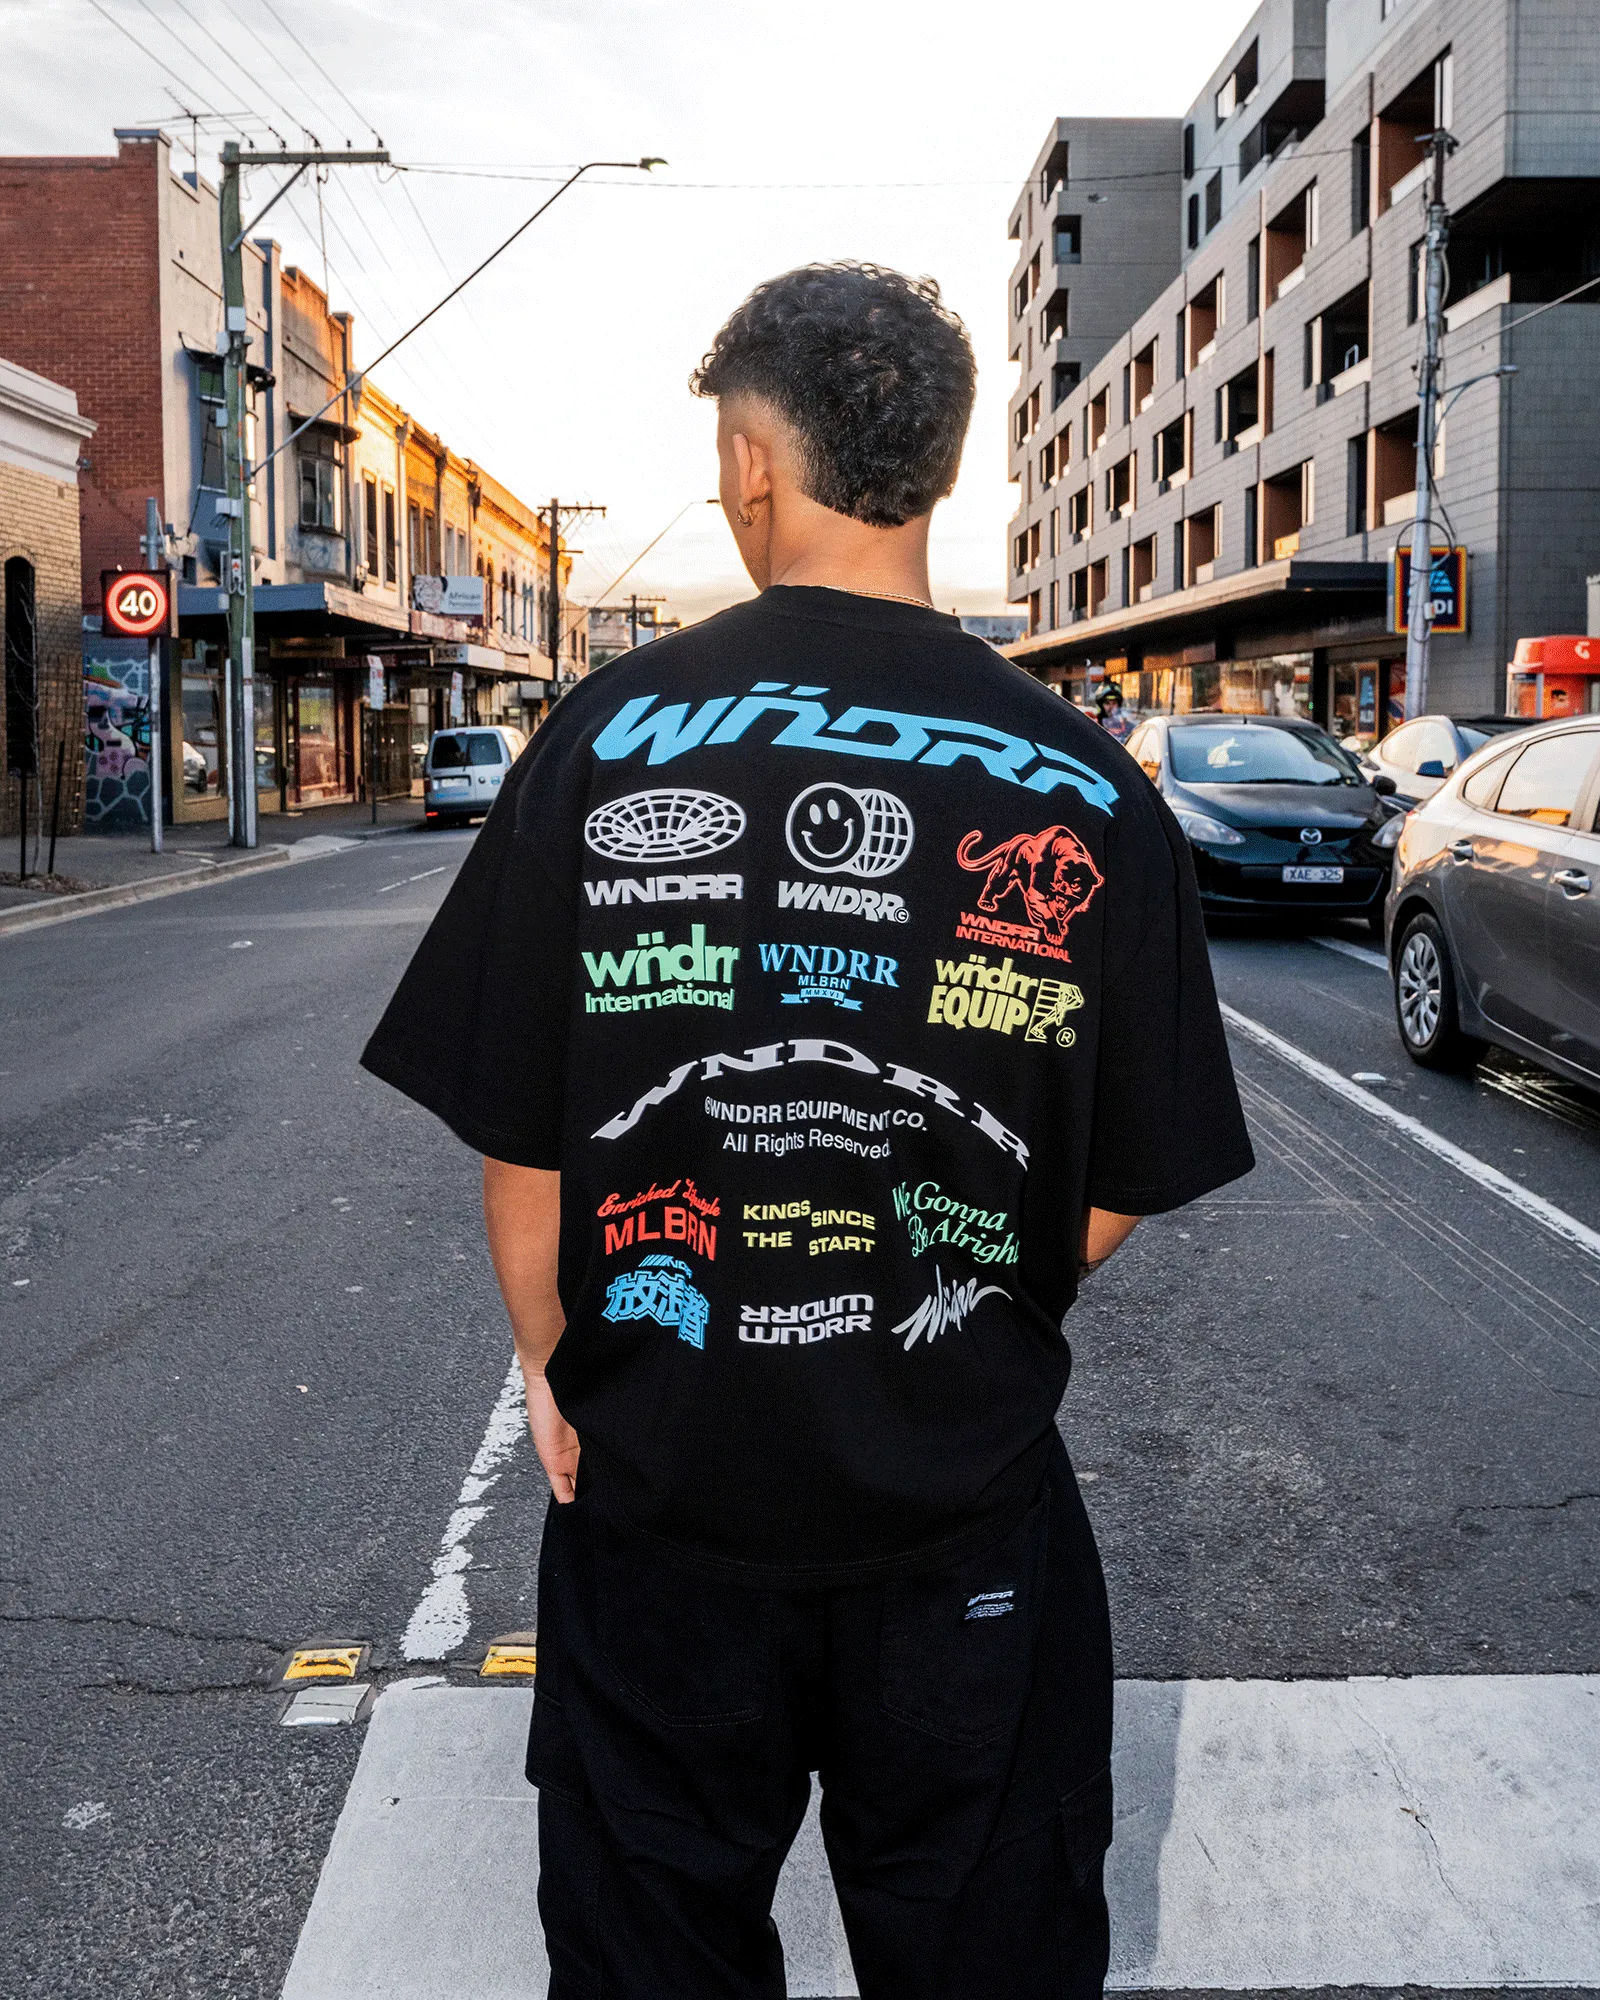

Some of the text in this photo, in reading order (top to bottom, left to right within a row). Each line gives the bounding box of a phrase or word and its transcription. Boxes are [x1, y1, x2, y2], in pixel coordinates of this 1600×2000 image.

[119, 589, 157, 617] 40
[584, 874, 744, 906] WNDRR
[1320, 869, 1343, 881] 325
[960, 911, 1040, 941] WNDRR
[956, 925, 1072, 963] INTERNATIONAL
[758, 944, 900, 988] WNDRR
[585, 982, 735, 1013] International
[798, 975, 851, 990] MLBRN
[927, 985, 1030, 1035] EQUIP
[591, 1039, 1030, 1172] WNDRR
[786, 1100, 891, 1132] EQUIPMENT
[893, 1109, 928, 1131] CO.
[722, 1132, 748, 1152] All
[755, 1131, 804, 1157] Rights
[597, 1180, 681, 1217] Enriched
[892, 1181, 1008, 1231] We Gonna
[743, 1200, 876, 1231] KINGS SINCE
[604, 1206, 717, 1261] MLBRN
[742, 1231, 876, 1256] THE START
[908, 1214, 929, 1257] Be
